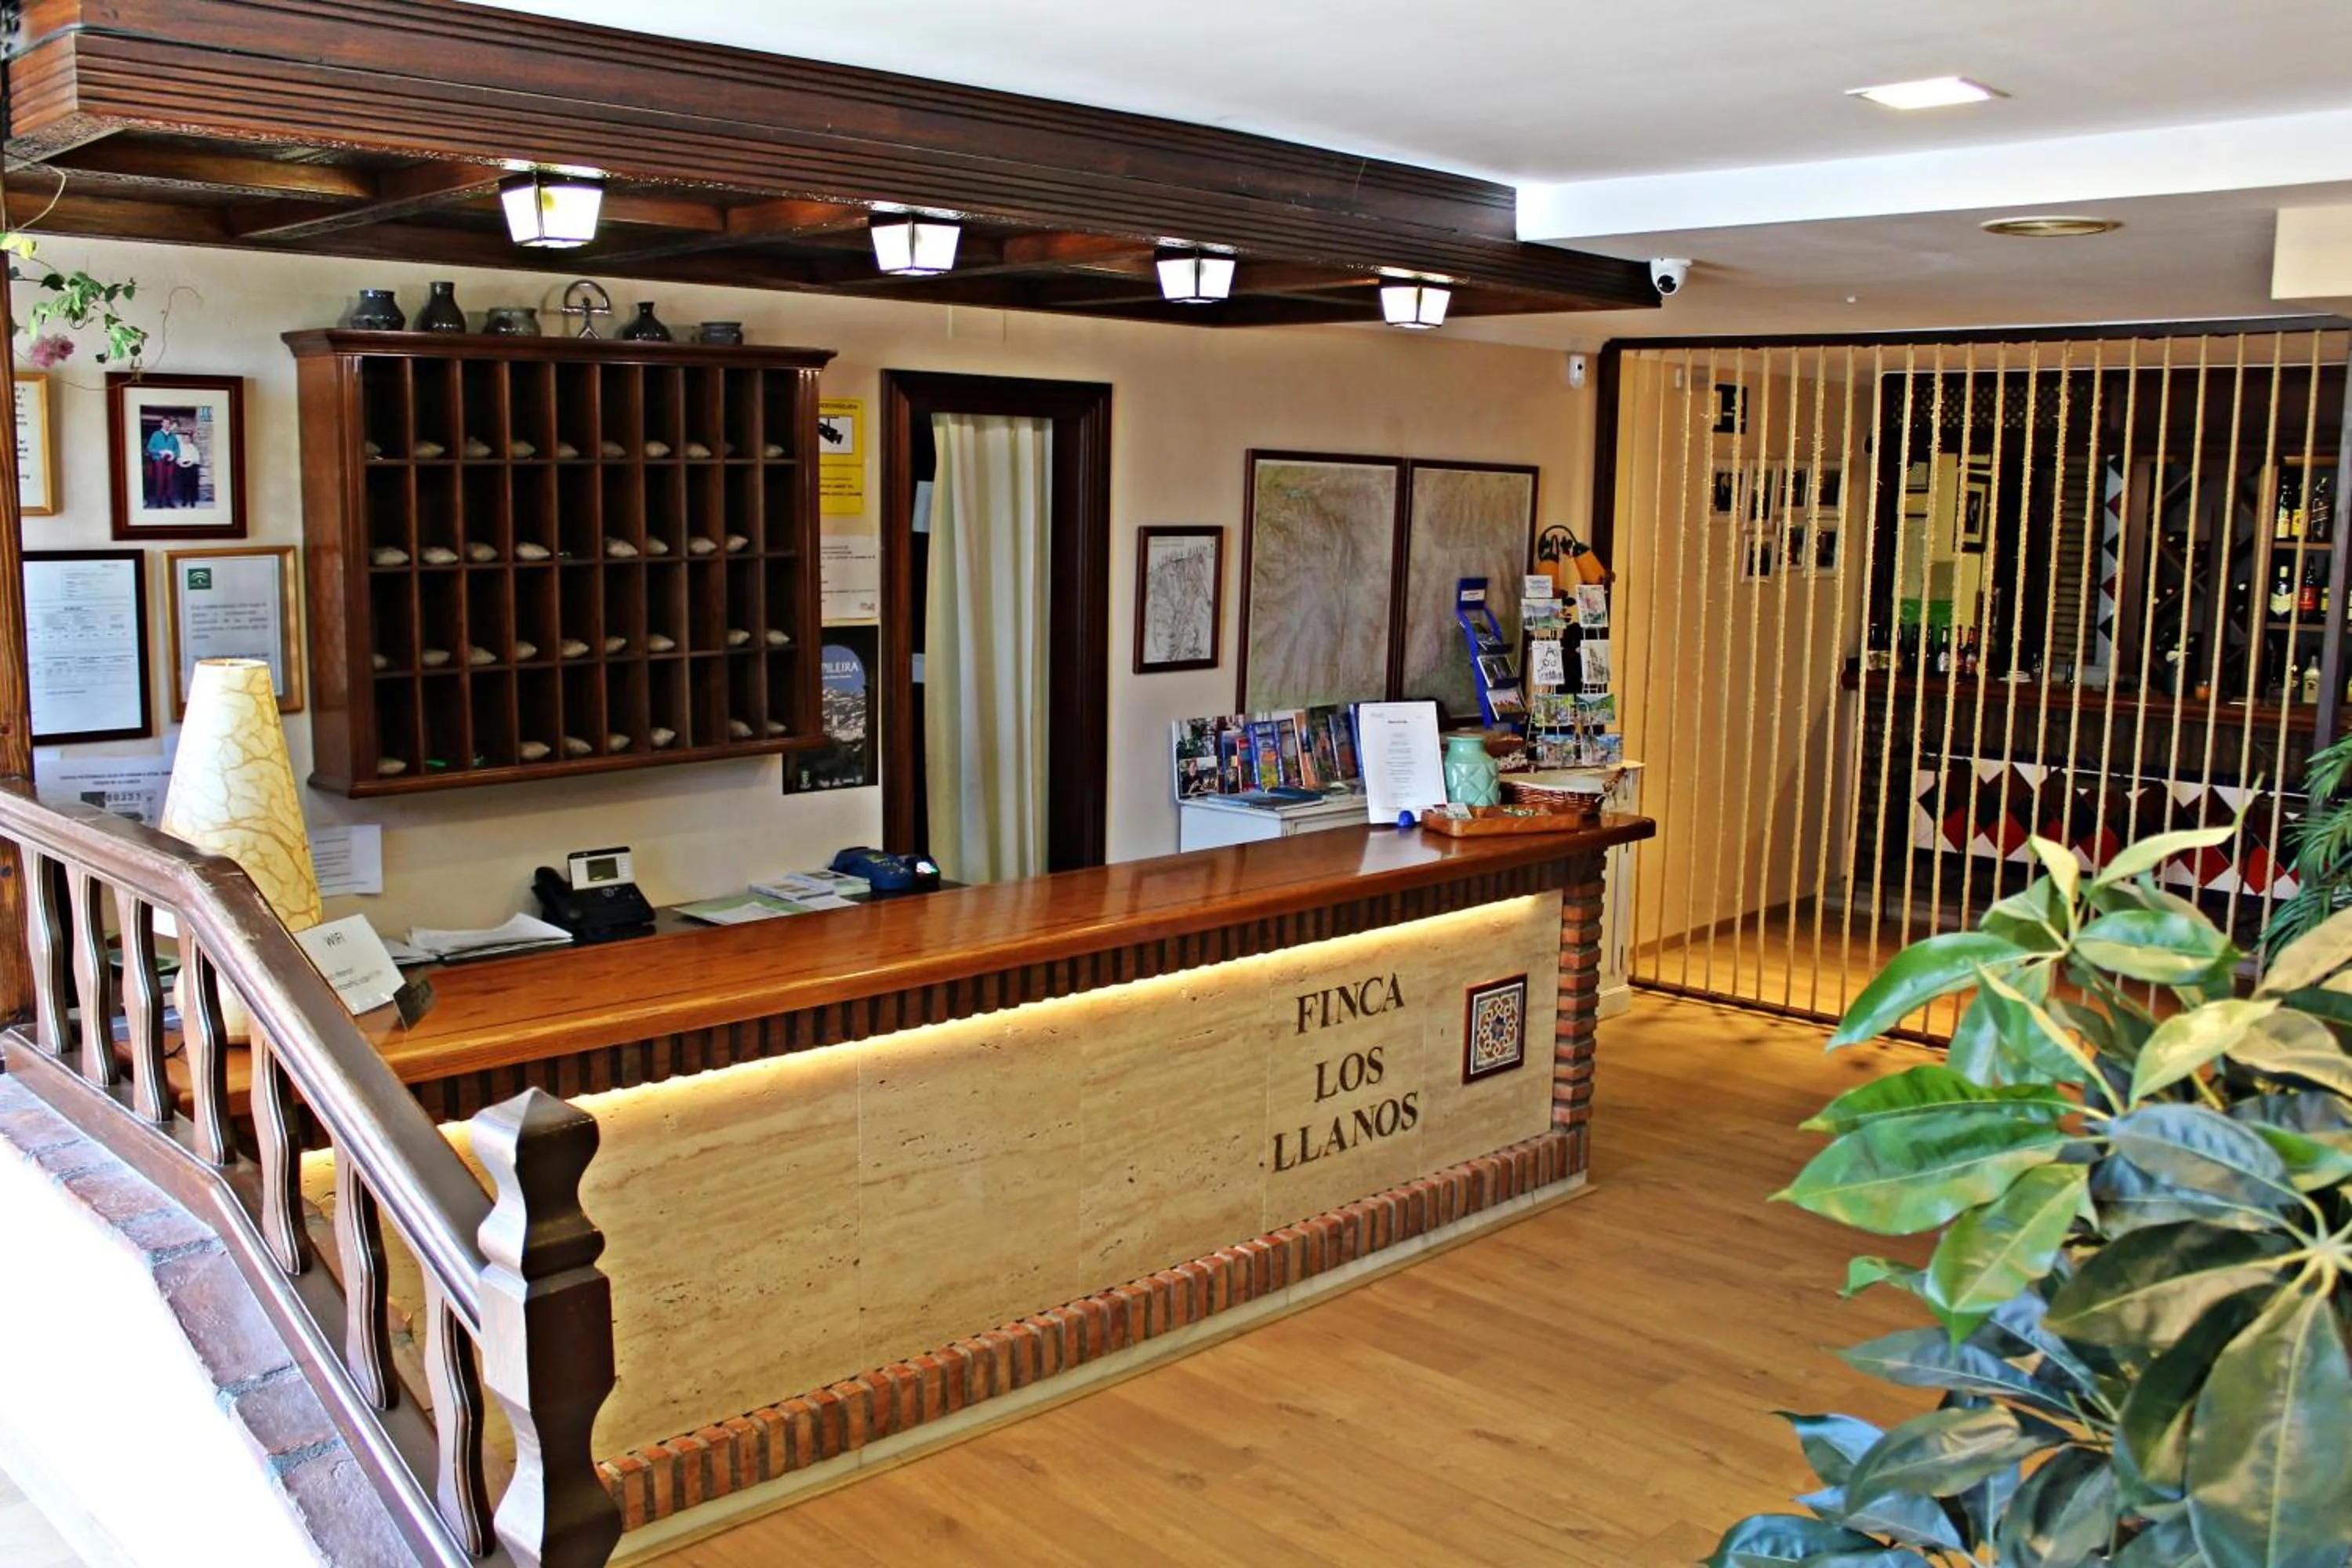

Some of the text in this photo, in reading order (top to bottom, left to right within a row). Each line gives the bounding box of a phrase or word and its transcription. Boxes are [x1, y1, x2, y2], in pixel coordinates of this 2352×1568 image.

[1295, 973, 1404, 1035] FINCA
[1314, 1046, 1384, 1103] LOS
[1272, 1091, 1419, 1173] LLANOS
